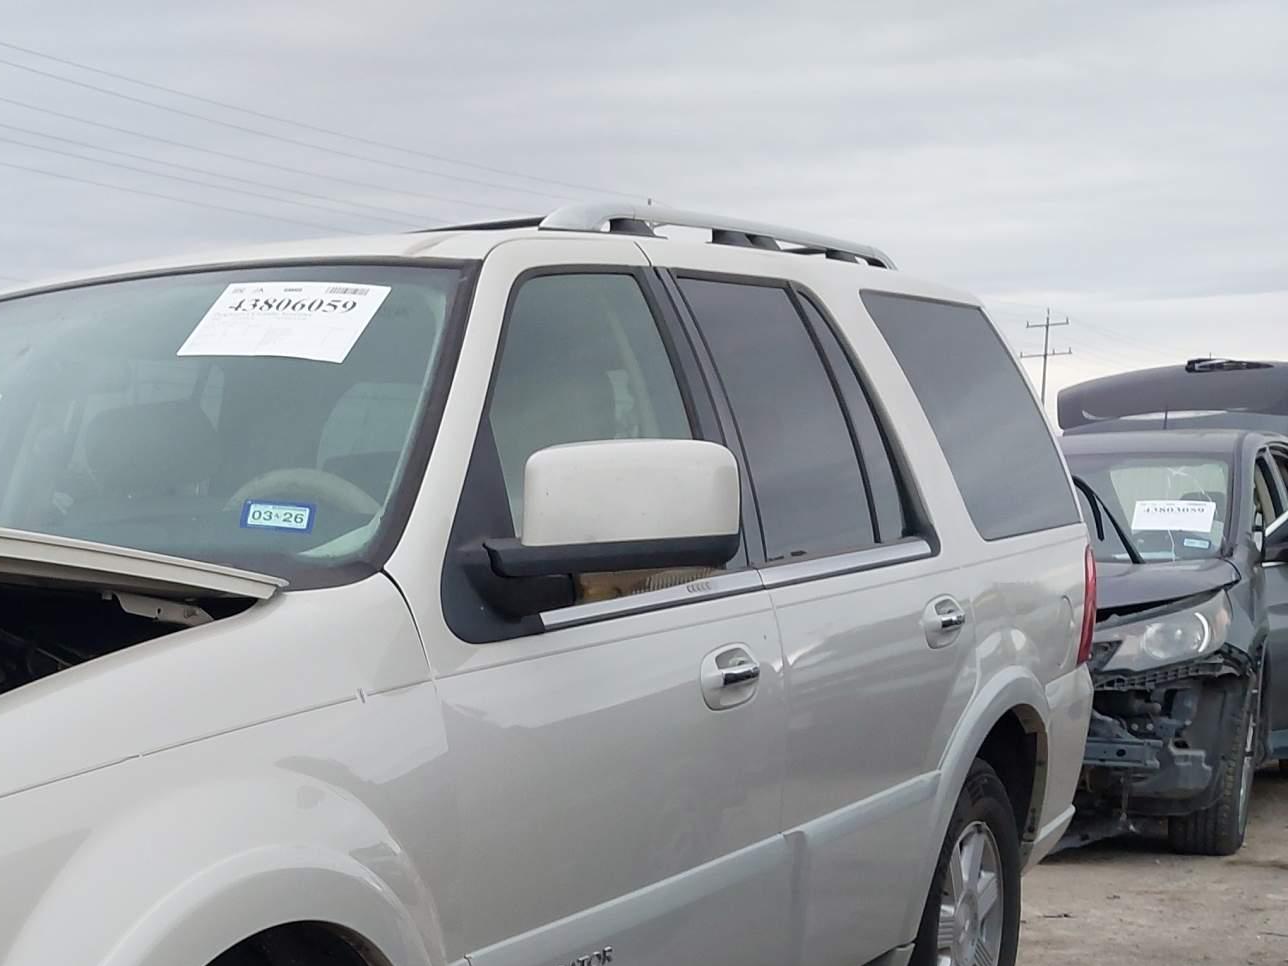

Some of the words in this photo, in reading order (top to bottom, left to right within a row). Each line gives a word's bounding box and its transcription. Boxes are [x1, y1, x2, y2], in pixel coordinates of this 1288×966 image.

[227, 297, 358, 313] 43806059
[251, 510, 273, 522] 03
[282, 512, 305, 524] 26
